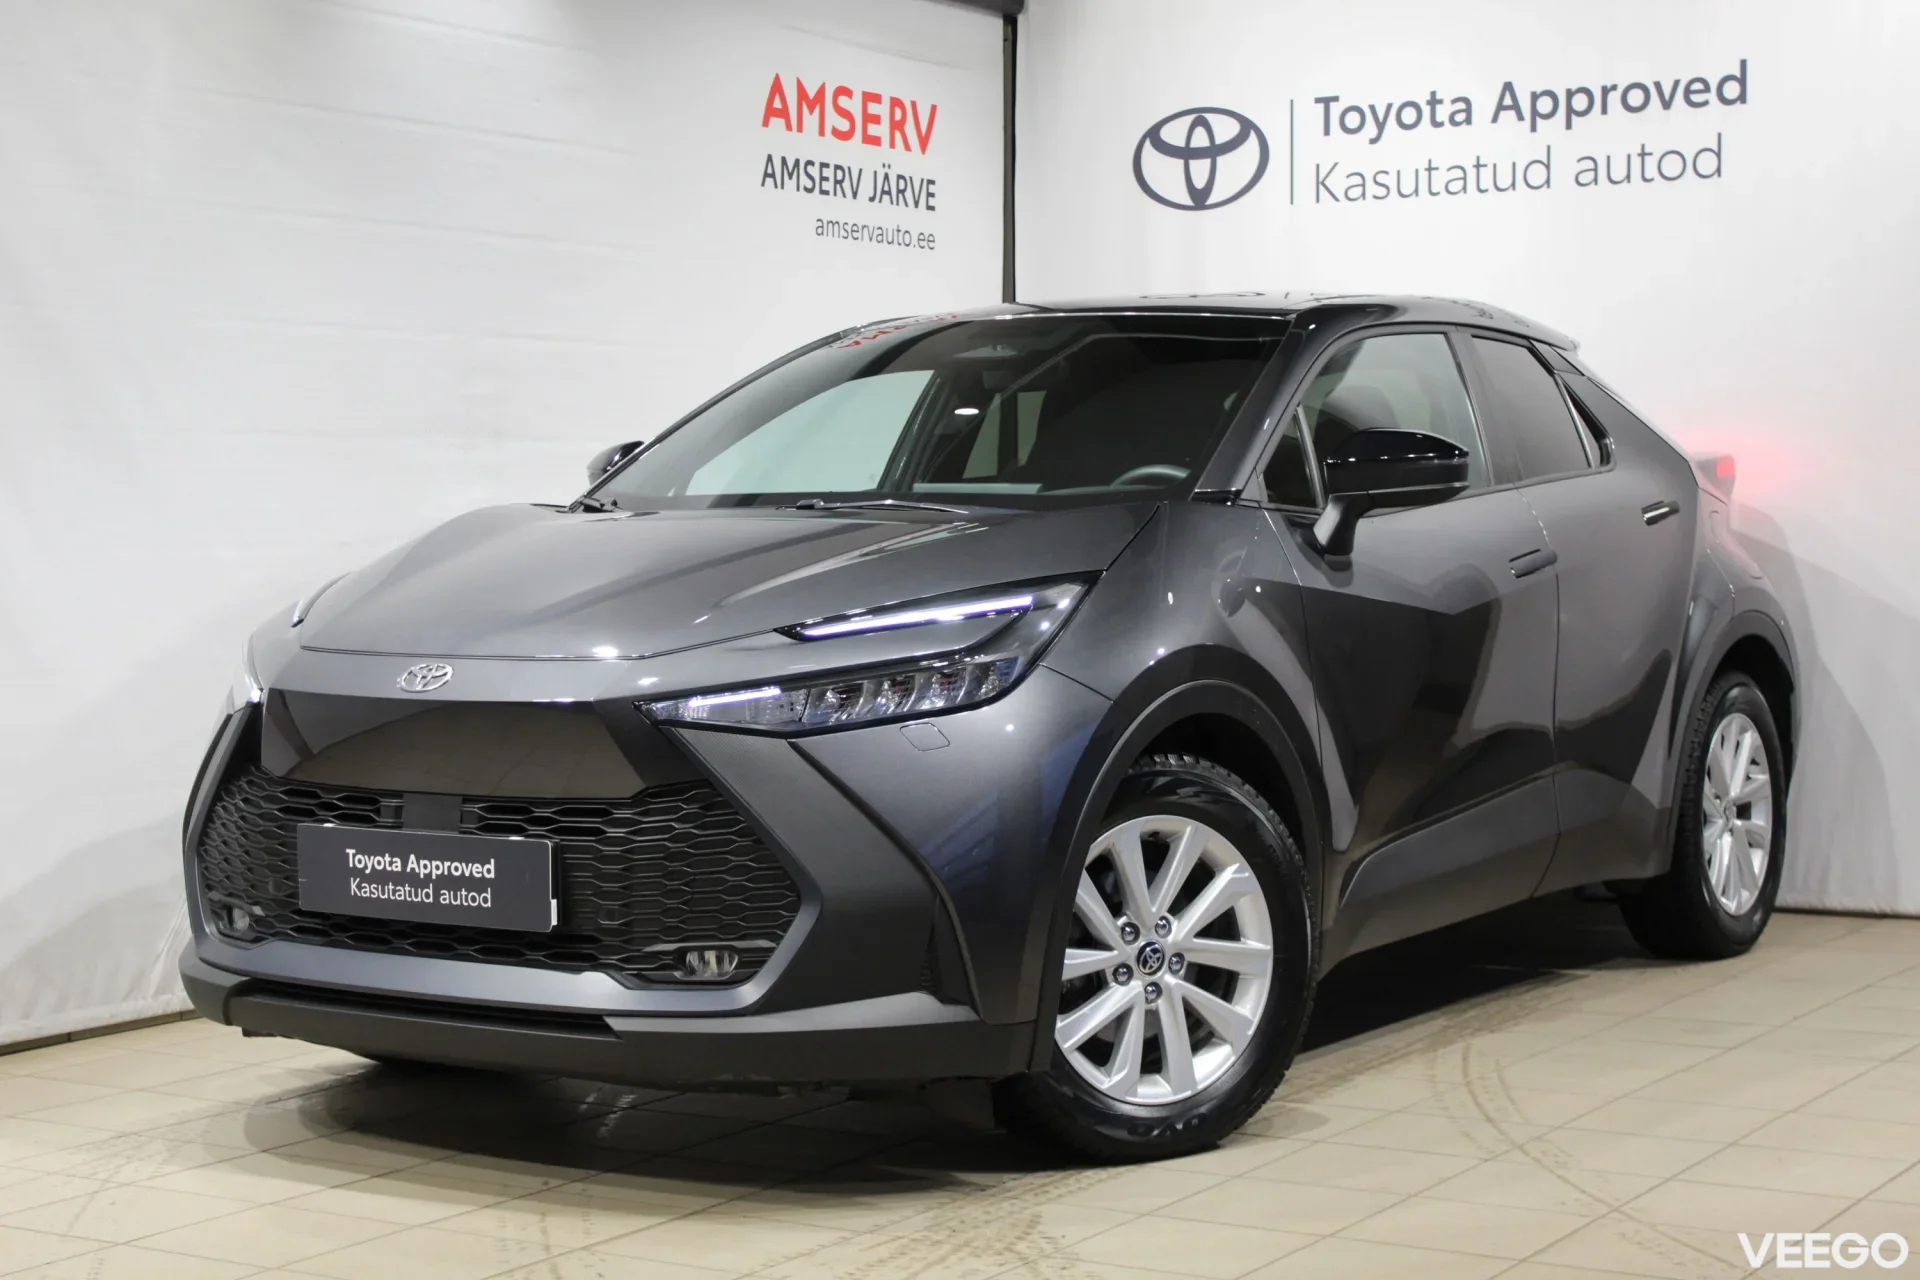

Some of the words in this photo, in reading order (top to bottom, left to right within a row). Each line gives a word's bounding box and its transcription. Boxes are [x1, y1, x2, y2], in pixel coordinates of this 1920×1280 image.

[761, 72, 938, 156] AMSERV
[1314, 90, 1473, 145] Toyota
[1490, 59, 1748, 133] Approved
[760, 153, 863, 201] AMSERV
[868, 162, 936, 212] JÄRVE
[1315, 145, 1551, 204] Kasutatud
[1574, 132, 1722, 188] autod
[815, 217, 936, 251] amservauto.ee
[345, 848, 402, 874] Toyota
[406, 854, 495, 880] Approved
[350, 877, 433, 903] Kasutatud
[440, 887, 492, 908] autod
